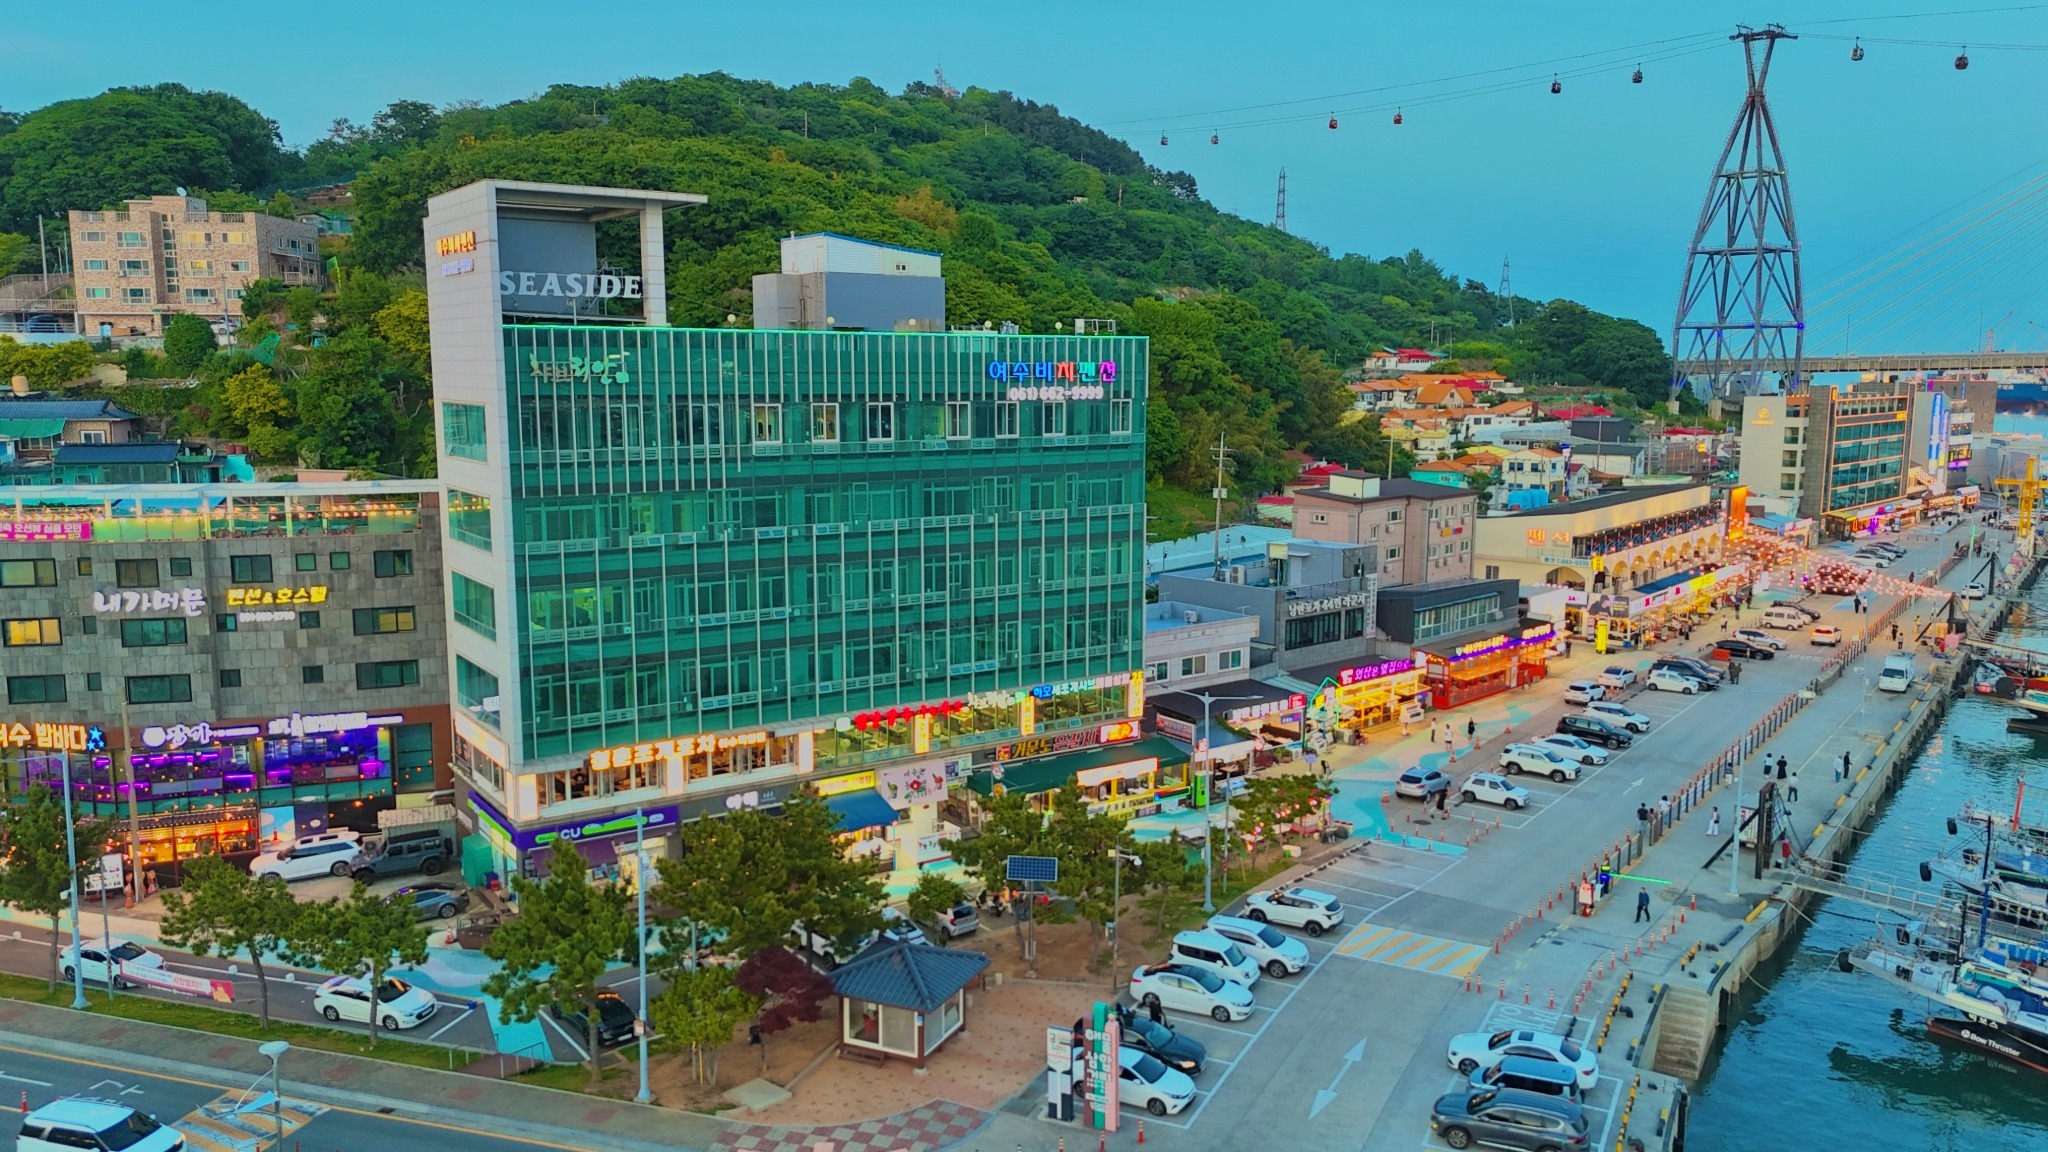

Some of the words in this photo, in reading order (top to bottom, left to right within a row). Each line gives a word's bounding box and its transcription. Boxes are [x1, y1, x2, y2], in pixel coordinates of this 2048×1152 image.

[500, 270, 643, 299] SEASIDE
[94, 589, 206, 617] 내가머문
[35, 722, 88, 751] 밤바다
[1053, 728, 1099, 752] 은갈치
[560, 826, 582, 841] CU
[1970, 1033, 1988, 1045] Bow
[1987, 1039, 2020, 1056] Thruster
